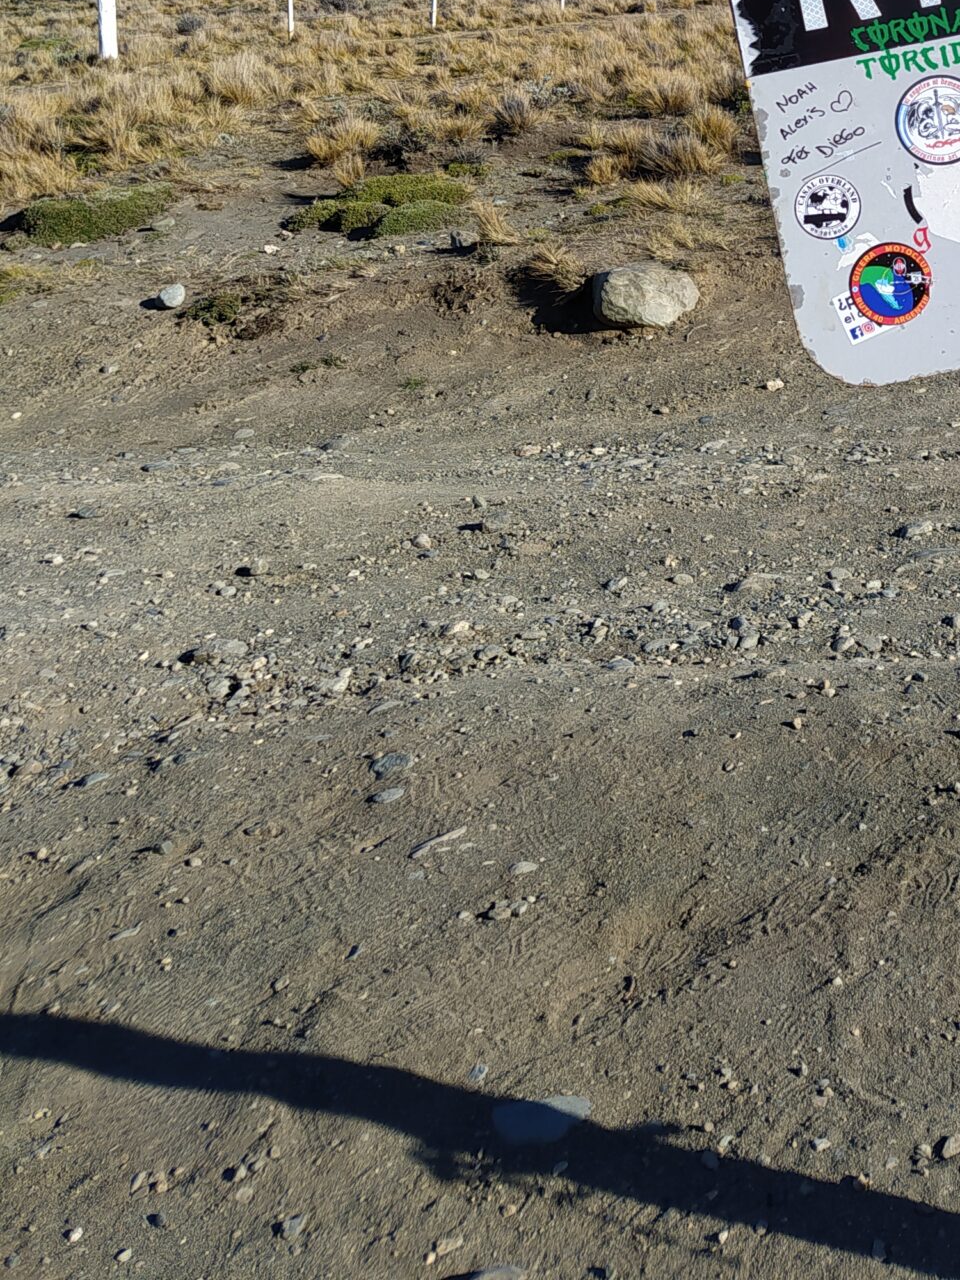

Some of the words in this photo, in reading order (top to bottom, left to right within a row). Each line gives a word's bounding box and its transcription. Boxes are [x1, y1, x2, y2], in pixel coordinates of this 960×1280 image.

[818, 176, 858, 205] OVERLAND
[853, 251, 877, 283] GILERA
[885, 245, 930, 275] MOTOCLUB
